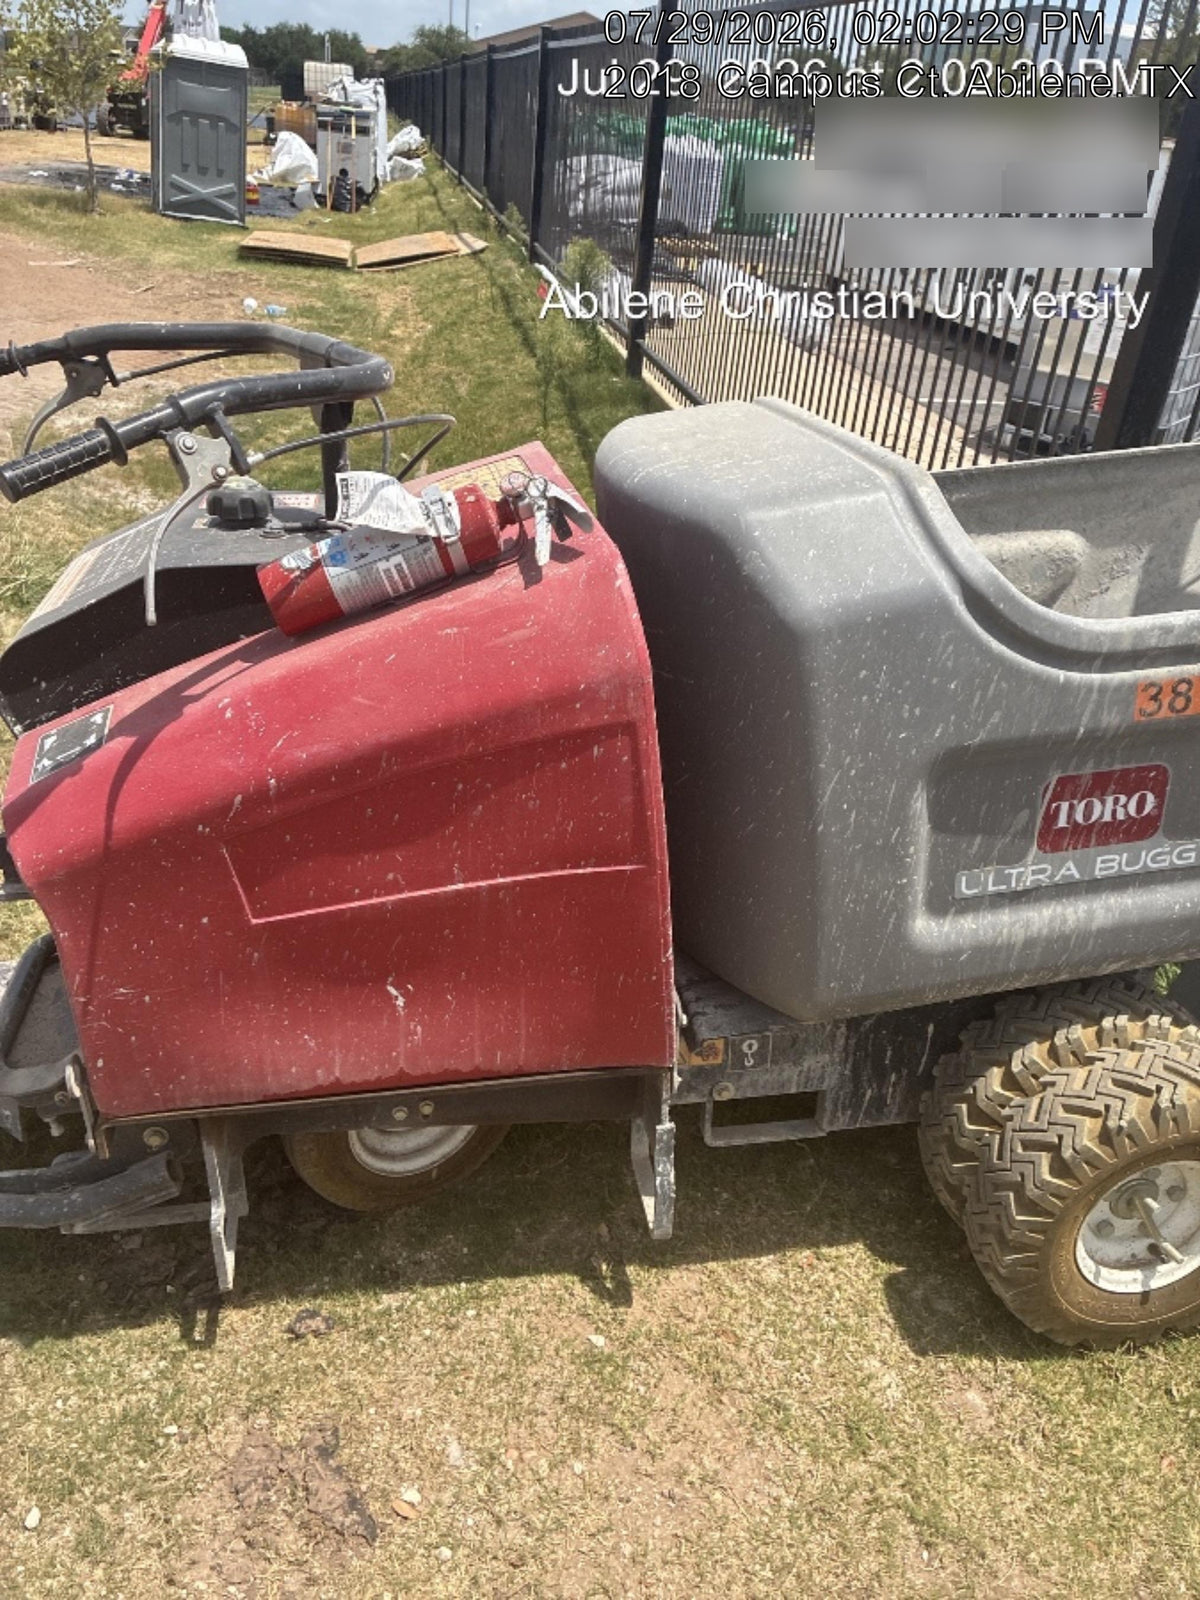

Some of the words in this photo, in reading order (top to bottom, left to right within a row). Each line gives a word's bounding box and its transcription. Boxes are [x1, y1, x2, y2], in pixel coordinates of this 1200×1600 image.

[1138, 677, 1194, 717] 38
[1051, 790, 1156, 829] TORO
[960, 860, 1081, 895] ULTRA
